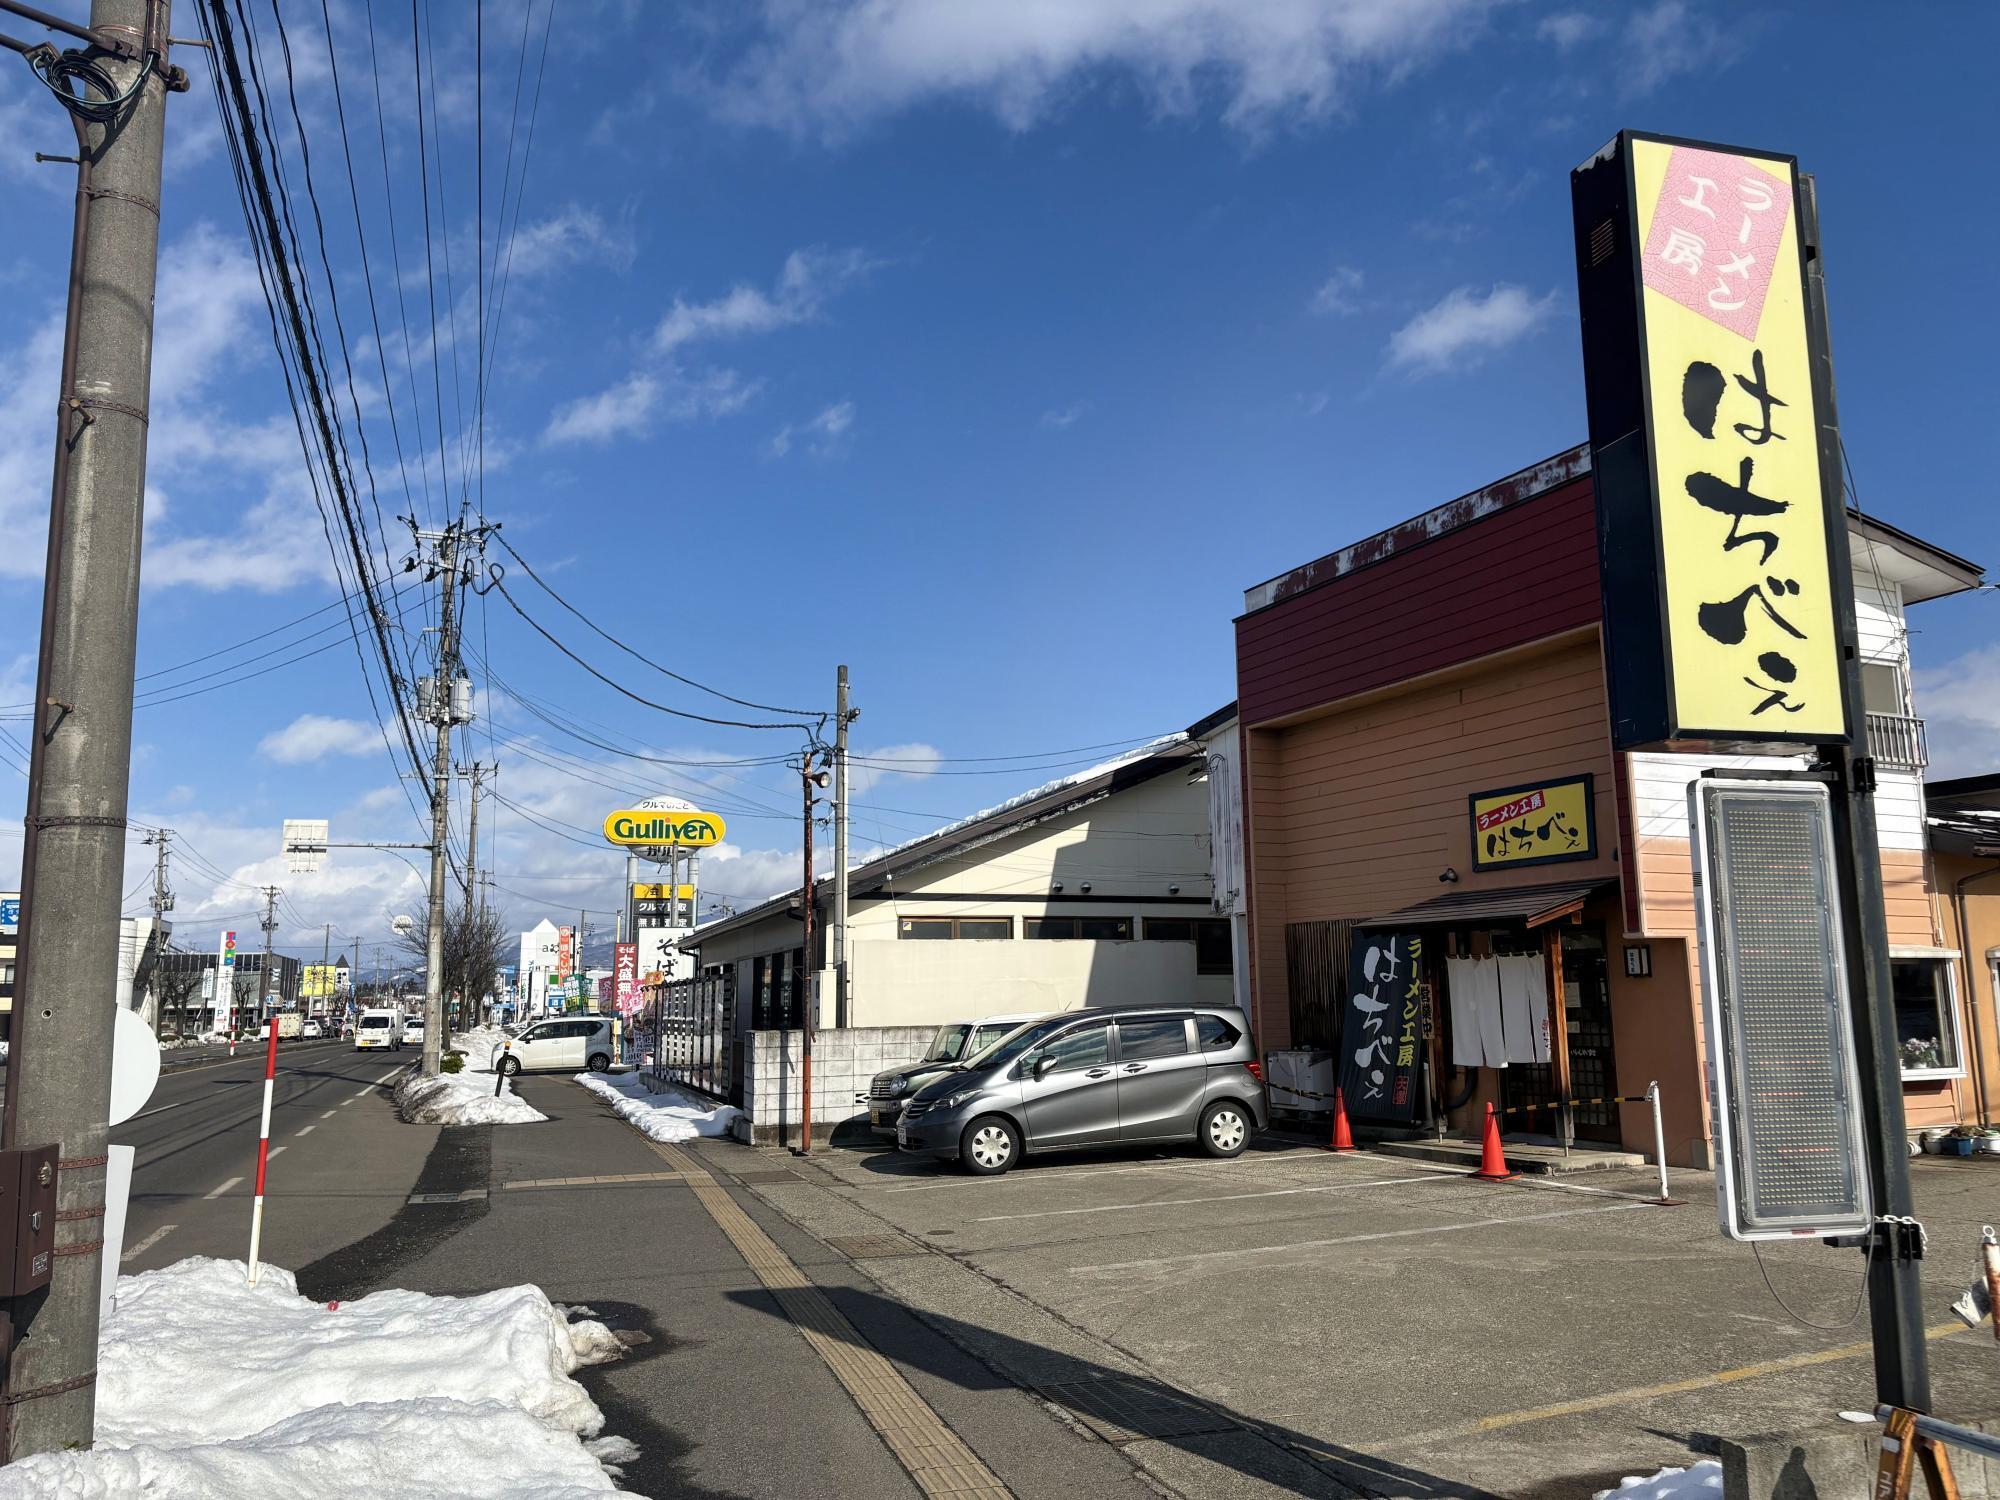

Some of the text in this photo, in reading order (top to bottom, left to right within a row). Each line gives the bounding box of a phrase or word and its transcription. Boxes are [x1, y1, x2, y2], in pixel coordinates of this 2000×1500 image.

[1660, 174, 1719, 276] 工房
[1708, 176, 1775, 310] ラーメン
[614, 817, 717, 840] Gulliver
[1480, 793, 1541, 828] ラーメン工房
[1397, 939, 1421, 1067] ラーメン工房
